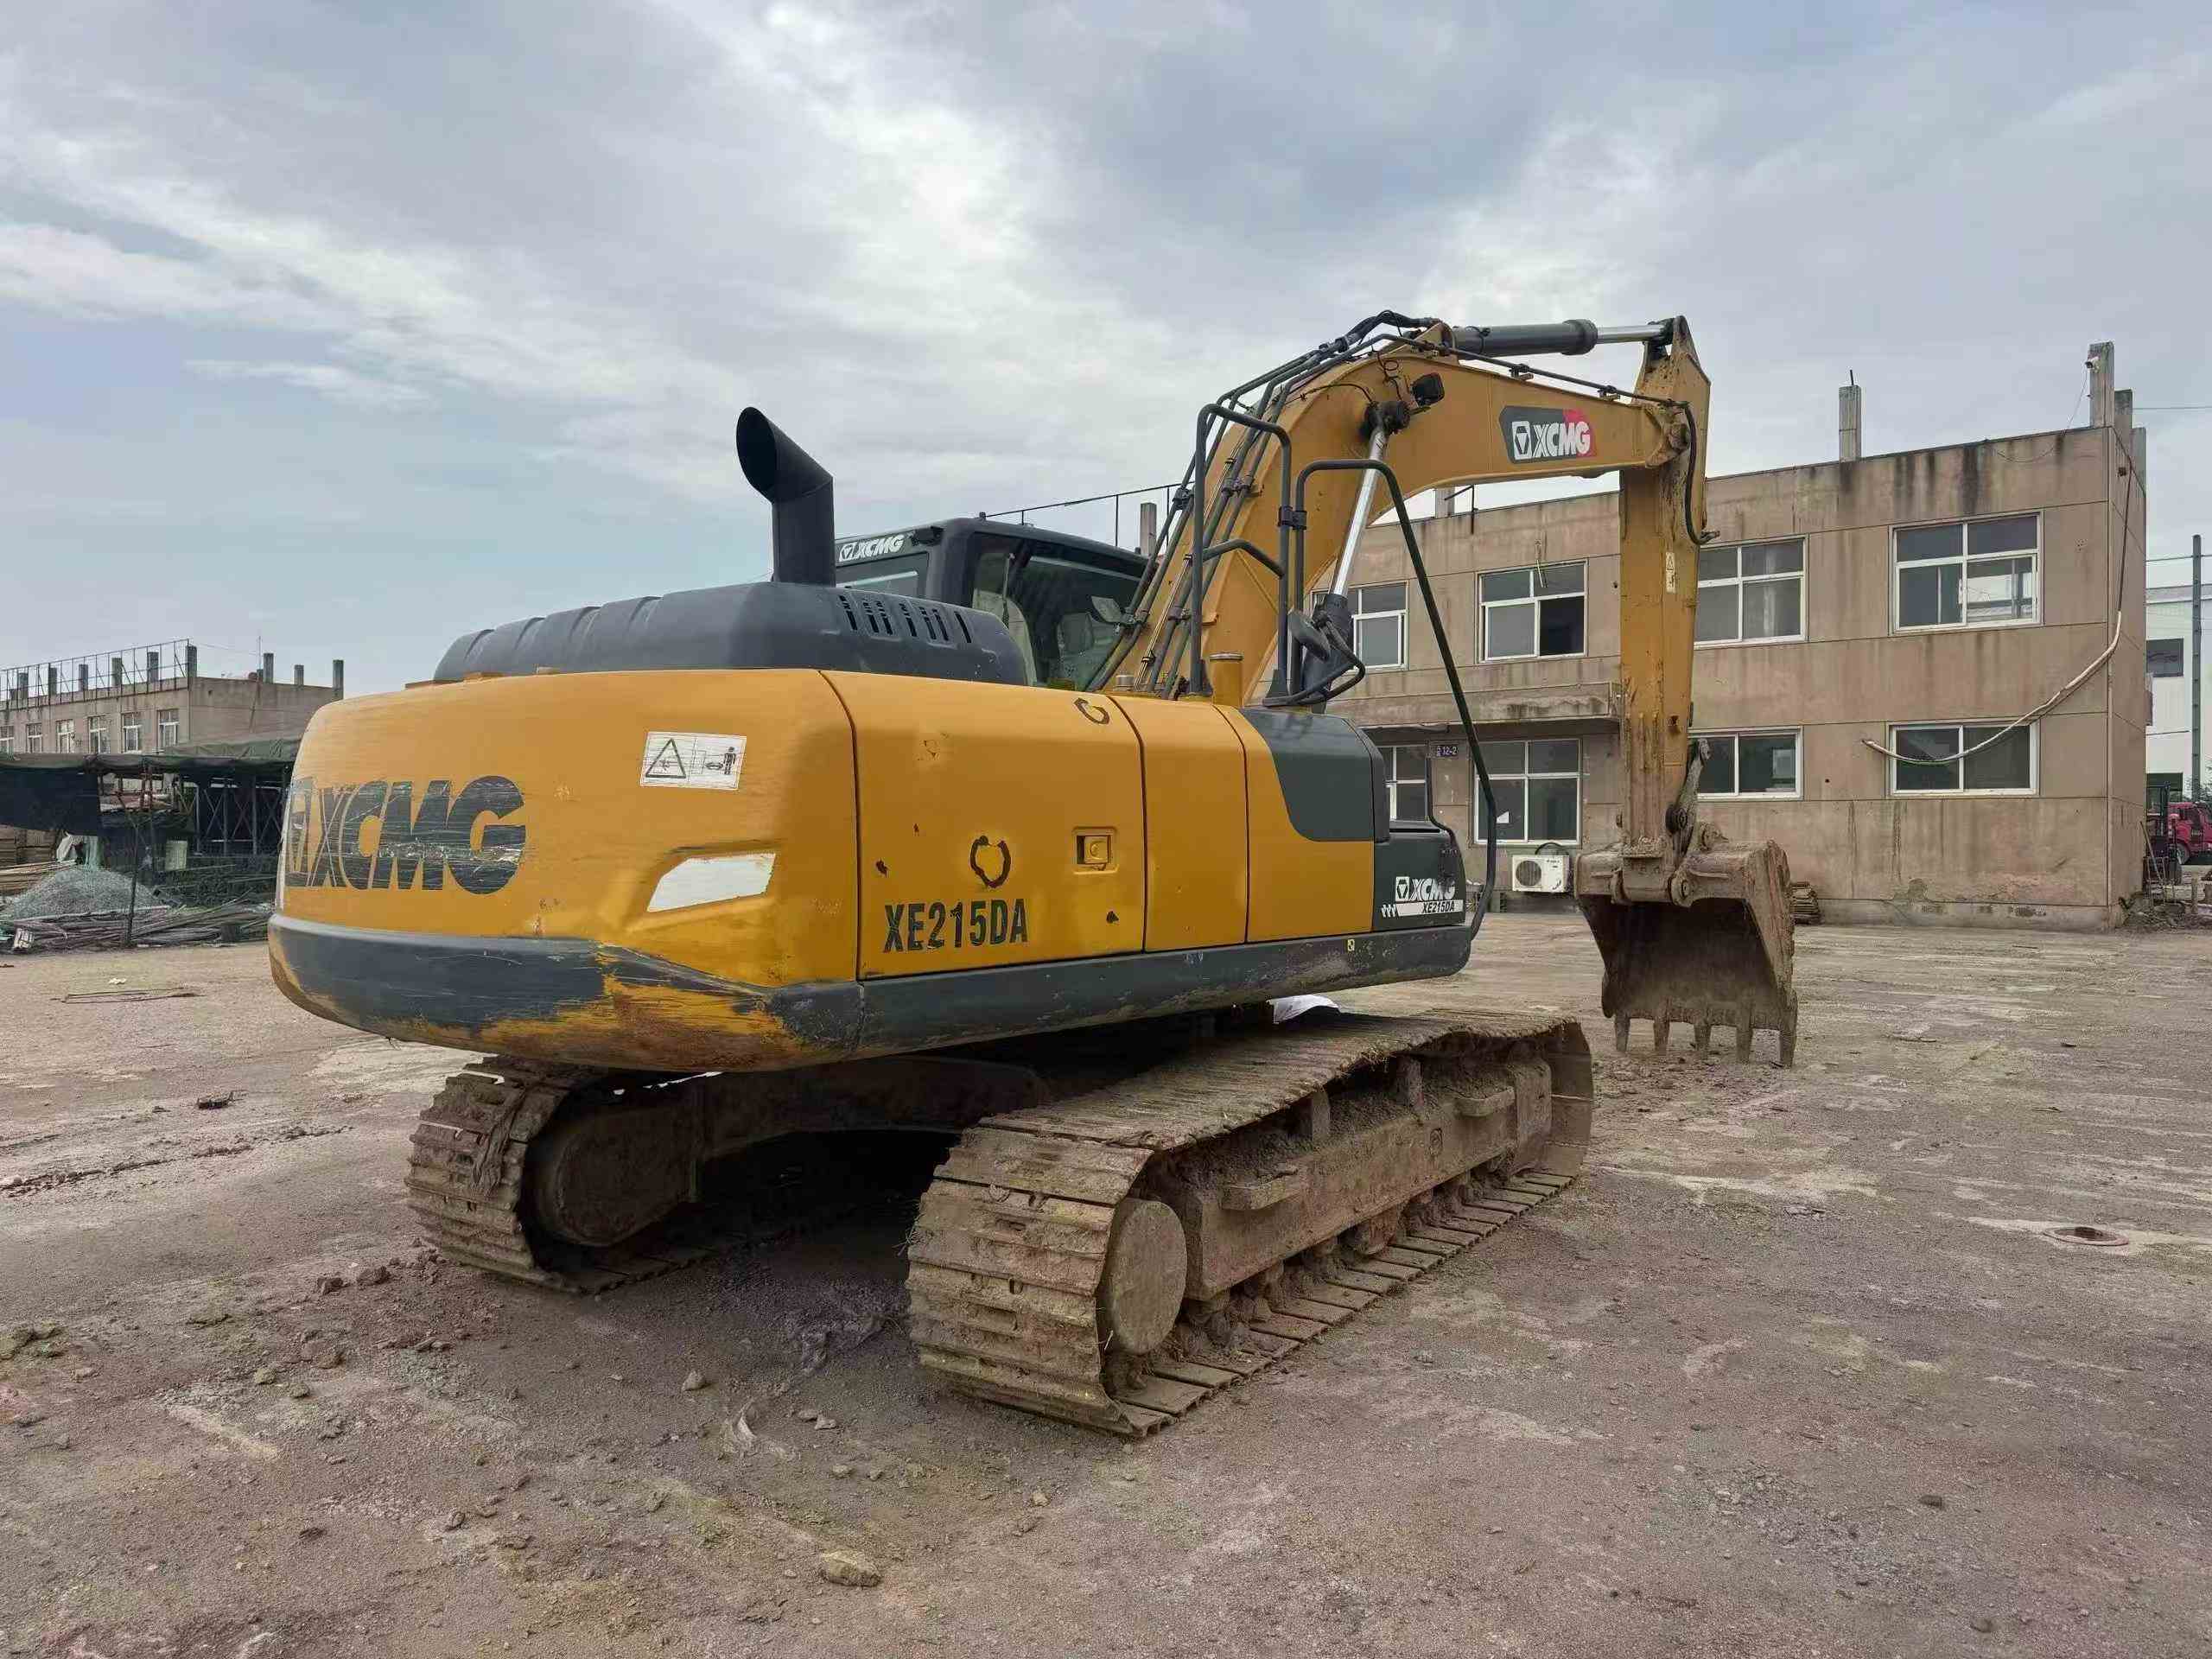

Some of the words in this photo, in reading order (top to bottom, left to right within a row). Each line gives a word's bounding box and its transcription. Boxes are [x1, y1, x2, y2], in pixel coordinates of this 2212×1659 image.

[1532, 421, 1591, 457] XCMG
[856, 535, 905, 559] XCMG
[305, 776, 525, 894] XCMG
[1422, 900, 1455, 913] XE215DA
[883, 898, 1028, 953] XE215DA
